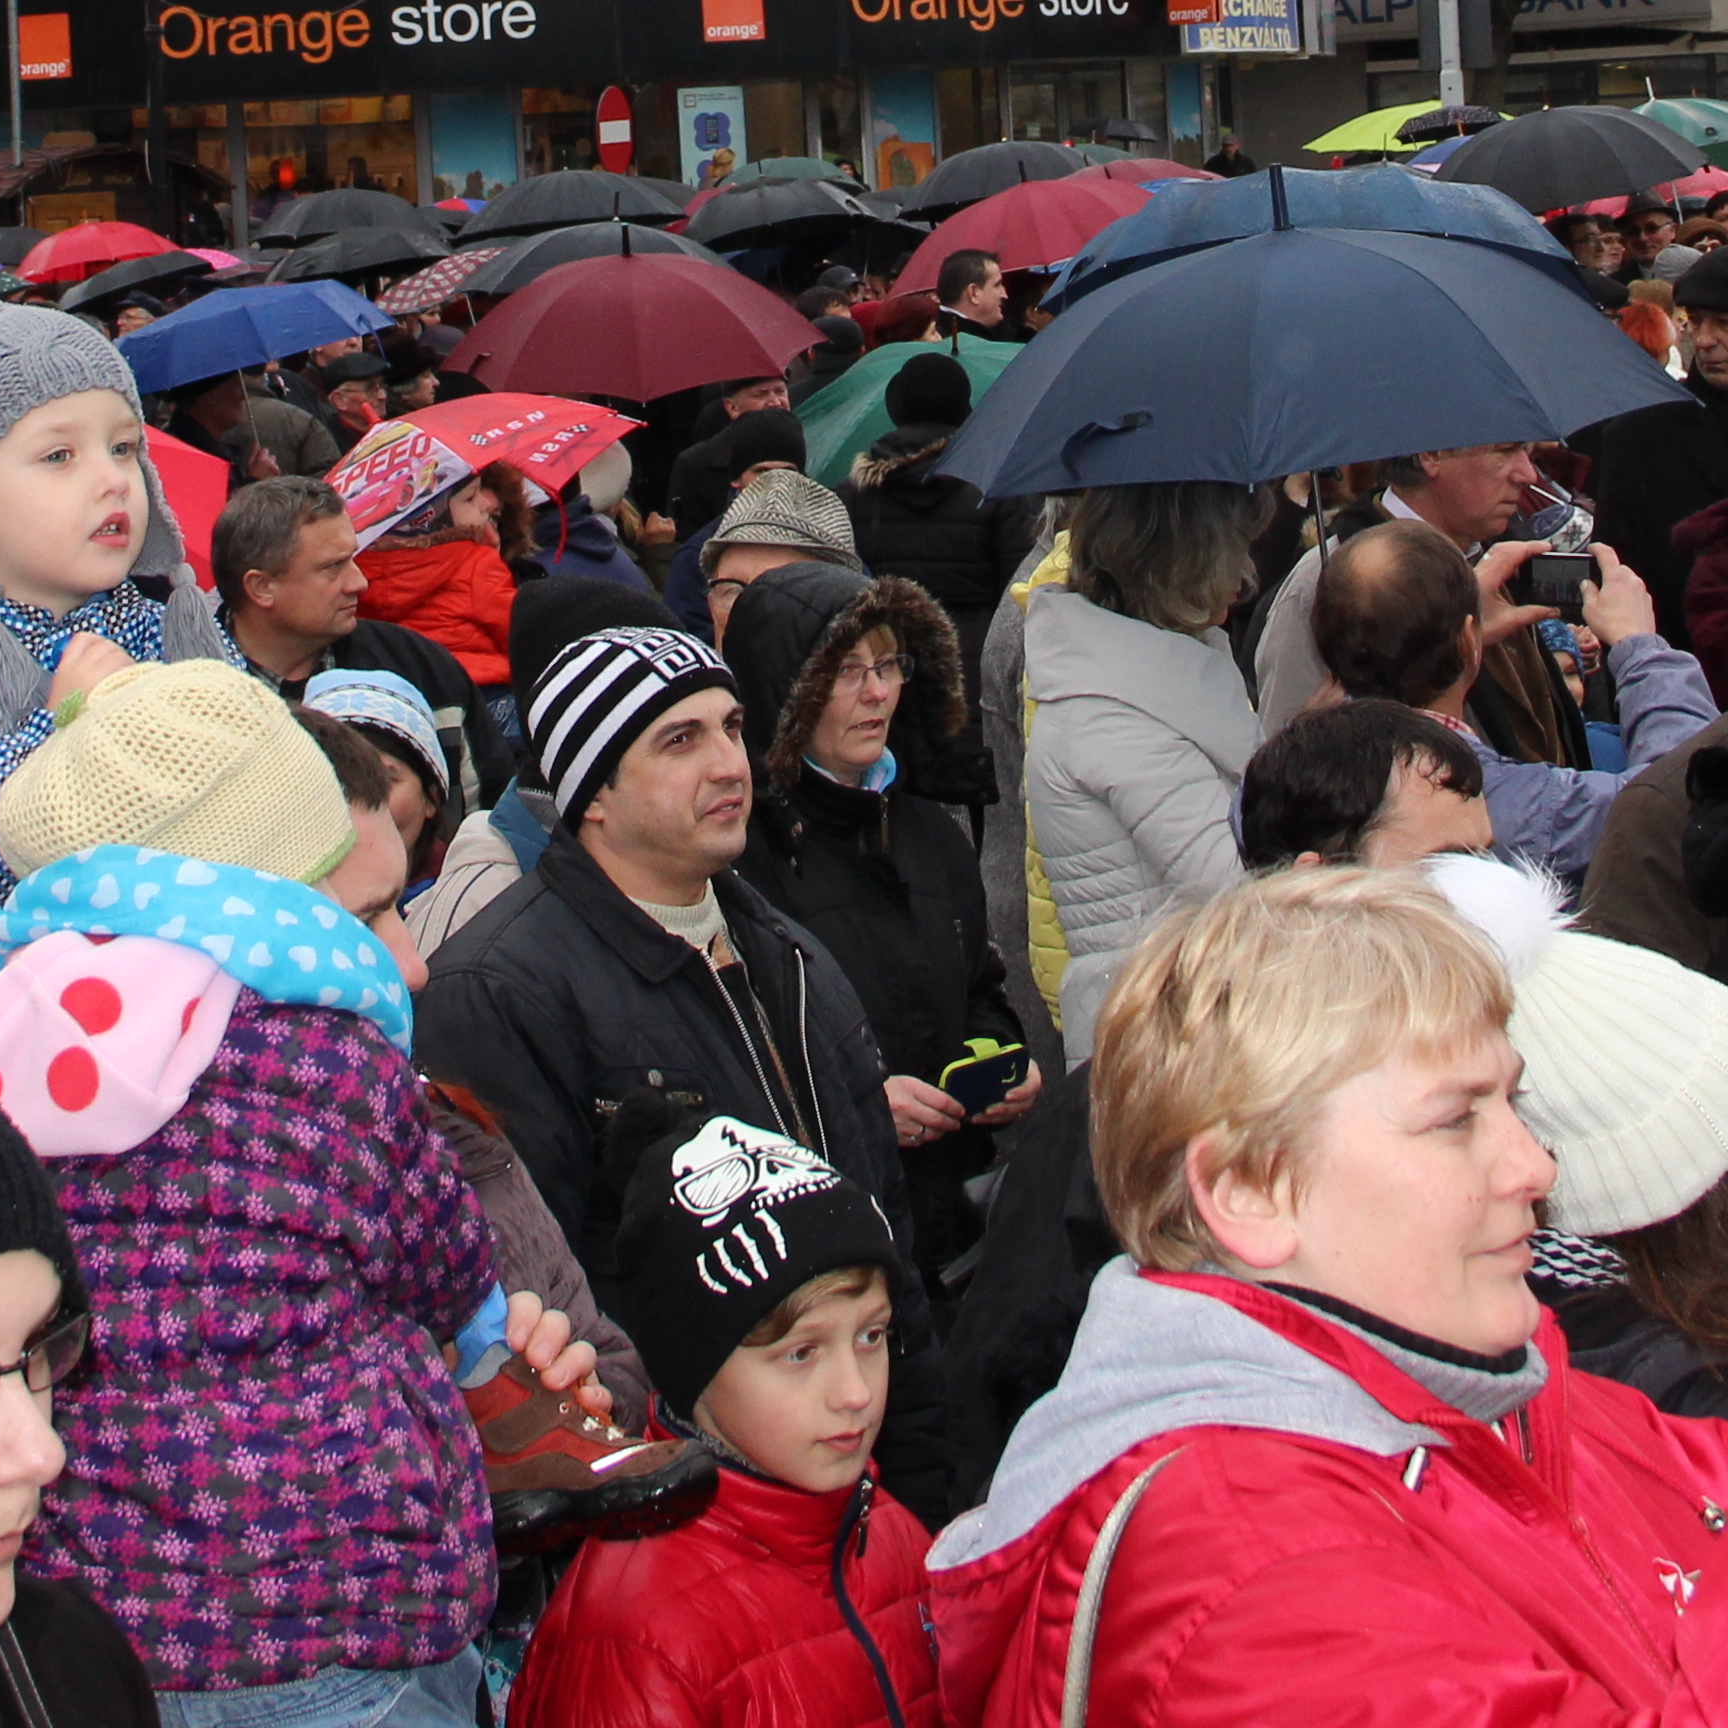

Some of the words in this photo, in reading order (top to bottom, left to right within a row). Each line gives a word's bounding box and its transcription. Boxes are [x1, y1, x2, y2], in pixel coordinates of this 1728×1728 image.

[1168, 8, 1209, 23] orange
[158, 5, 371, 63] Orange
[705, 22, 760, 40] orange
[1198, 21, 1292, 50] PÉNZVÁLTÓ
